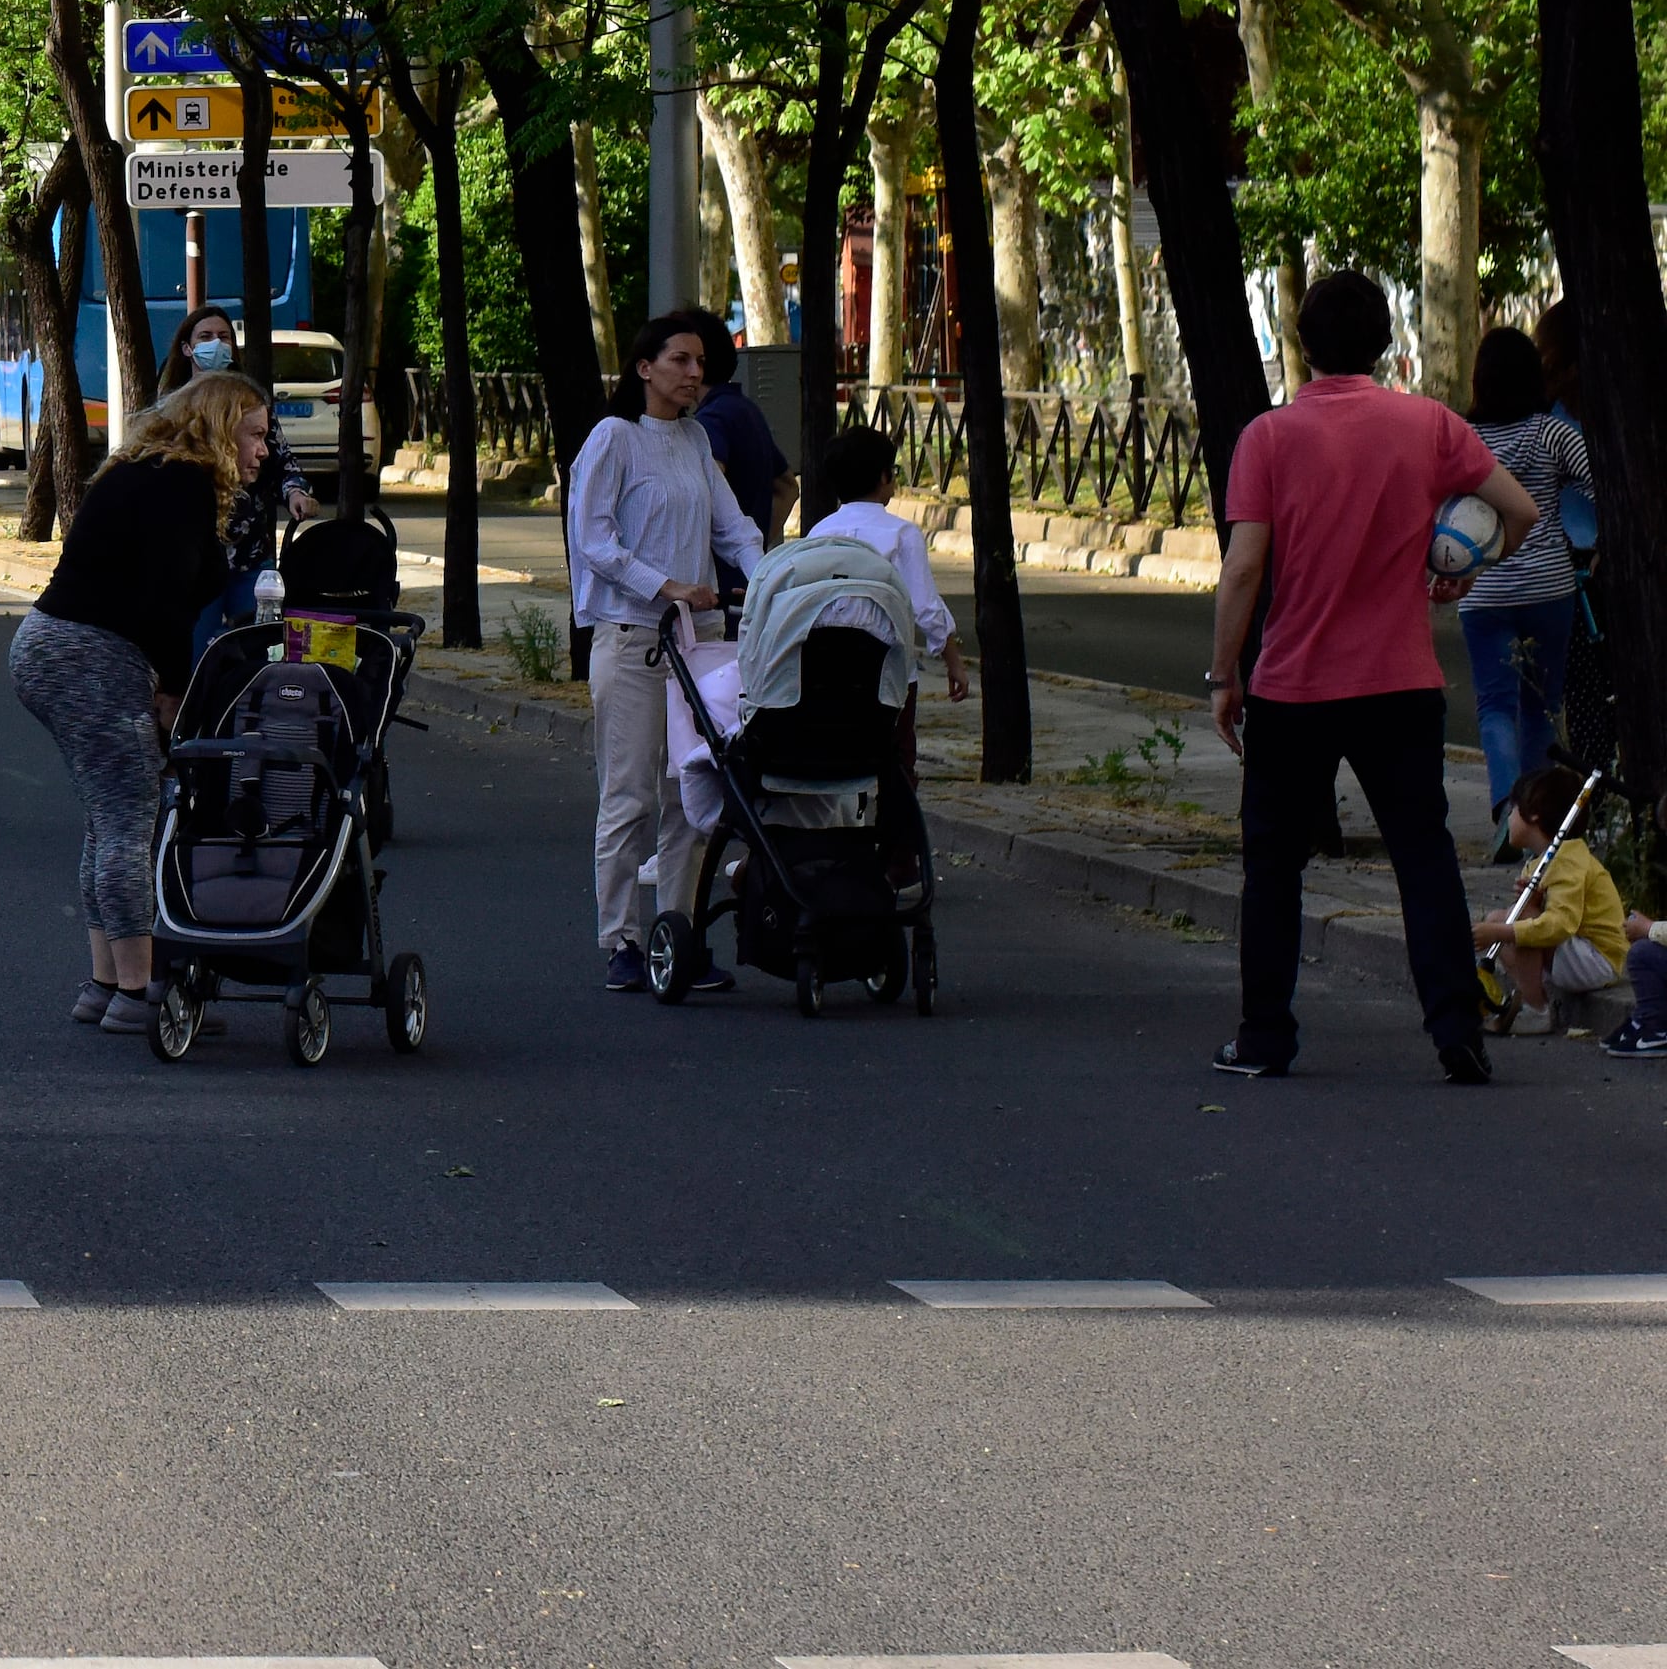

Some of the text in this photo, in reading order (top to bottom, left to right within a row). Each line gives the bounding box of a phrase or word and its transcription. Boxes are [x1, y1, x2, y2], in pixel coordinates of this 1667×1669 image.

[137, 160, 289, 179] Ministeri de
[137, 182, 231, 200] Defensa
